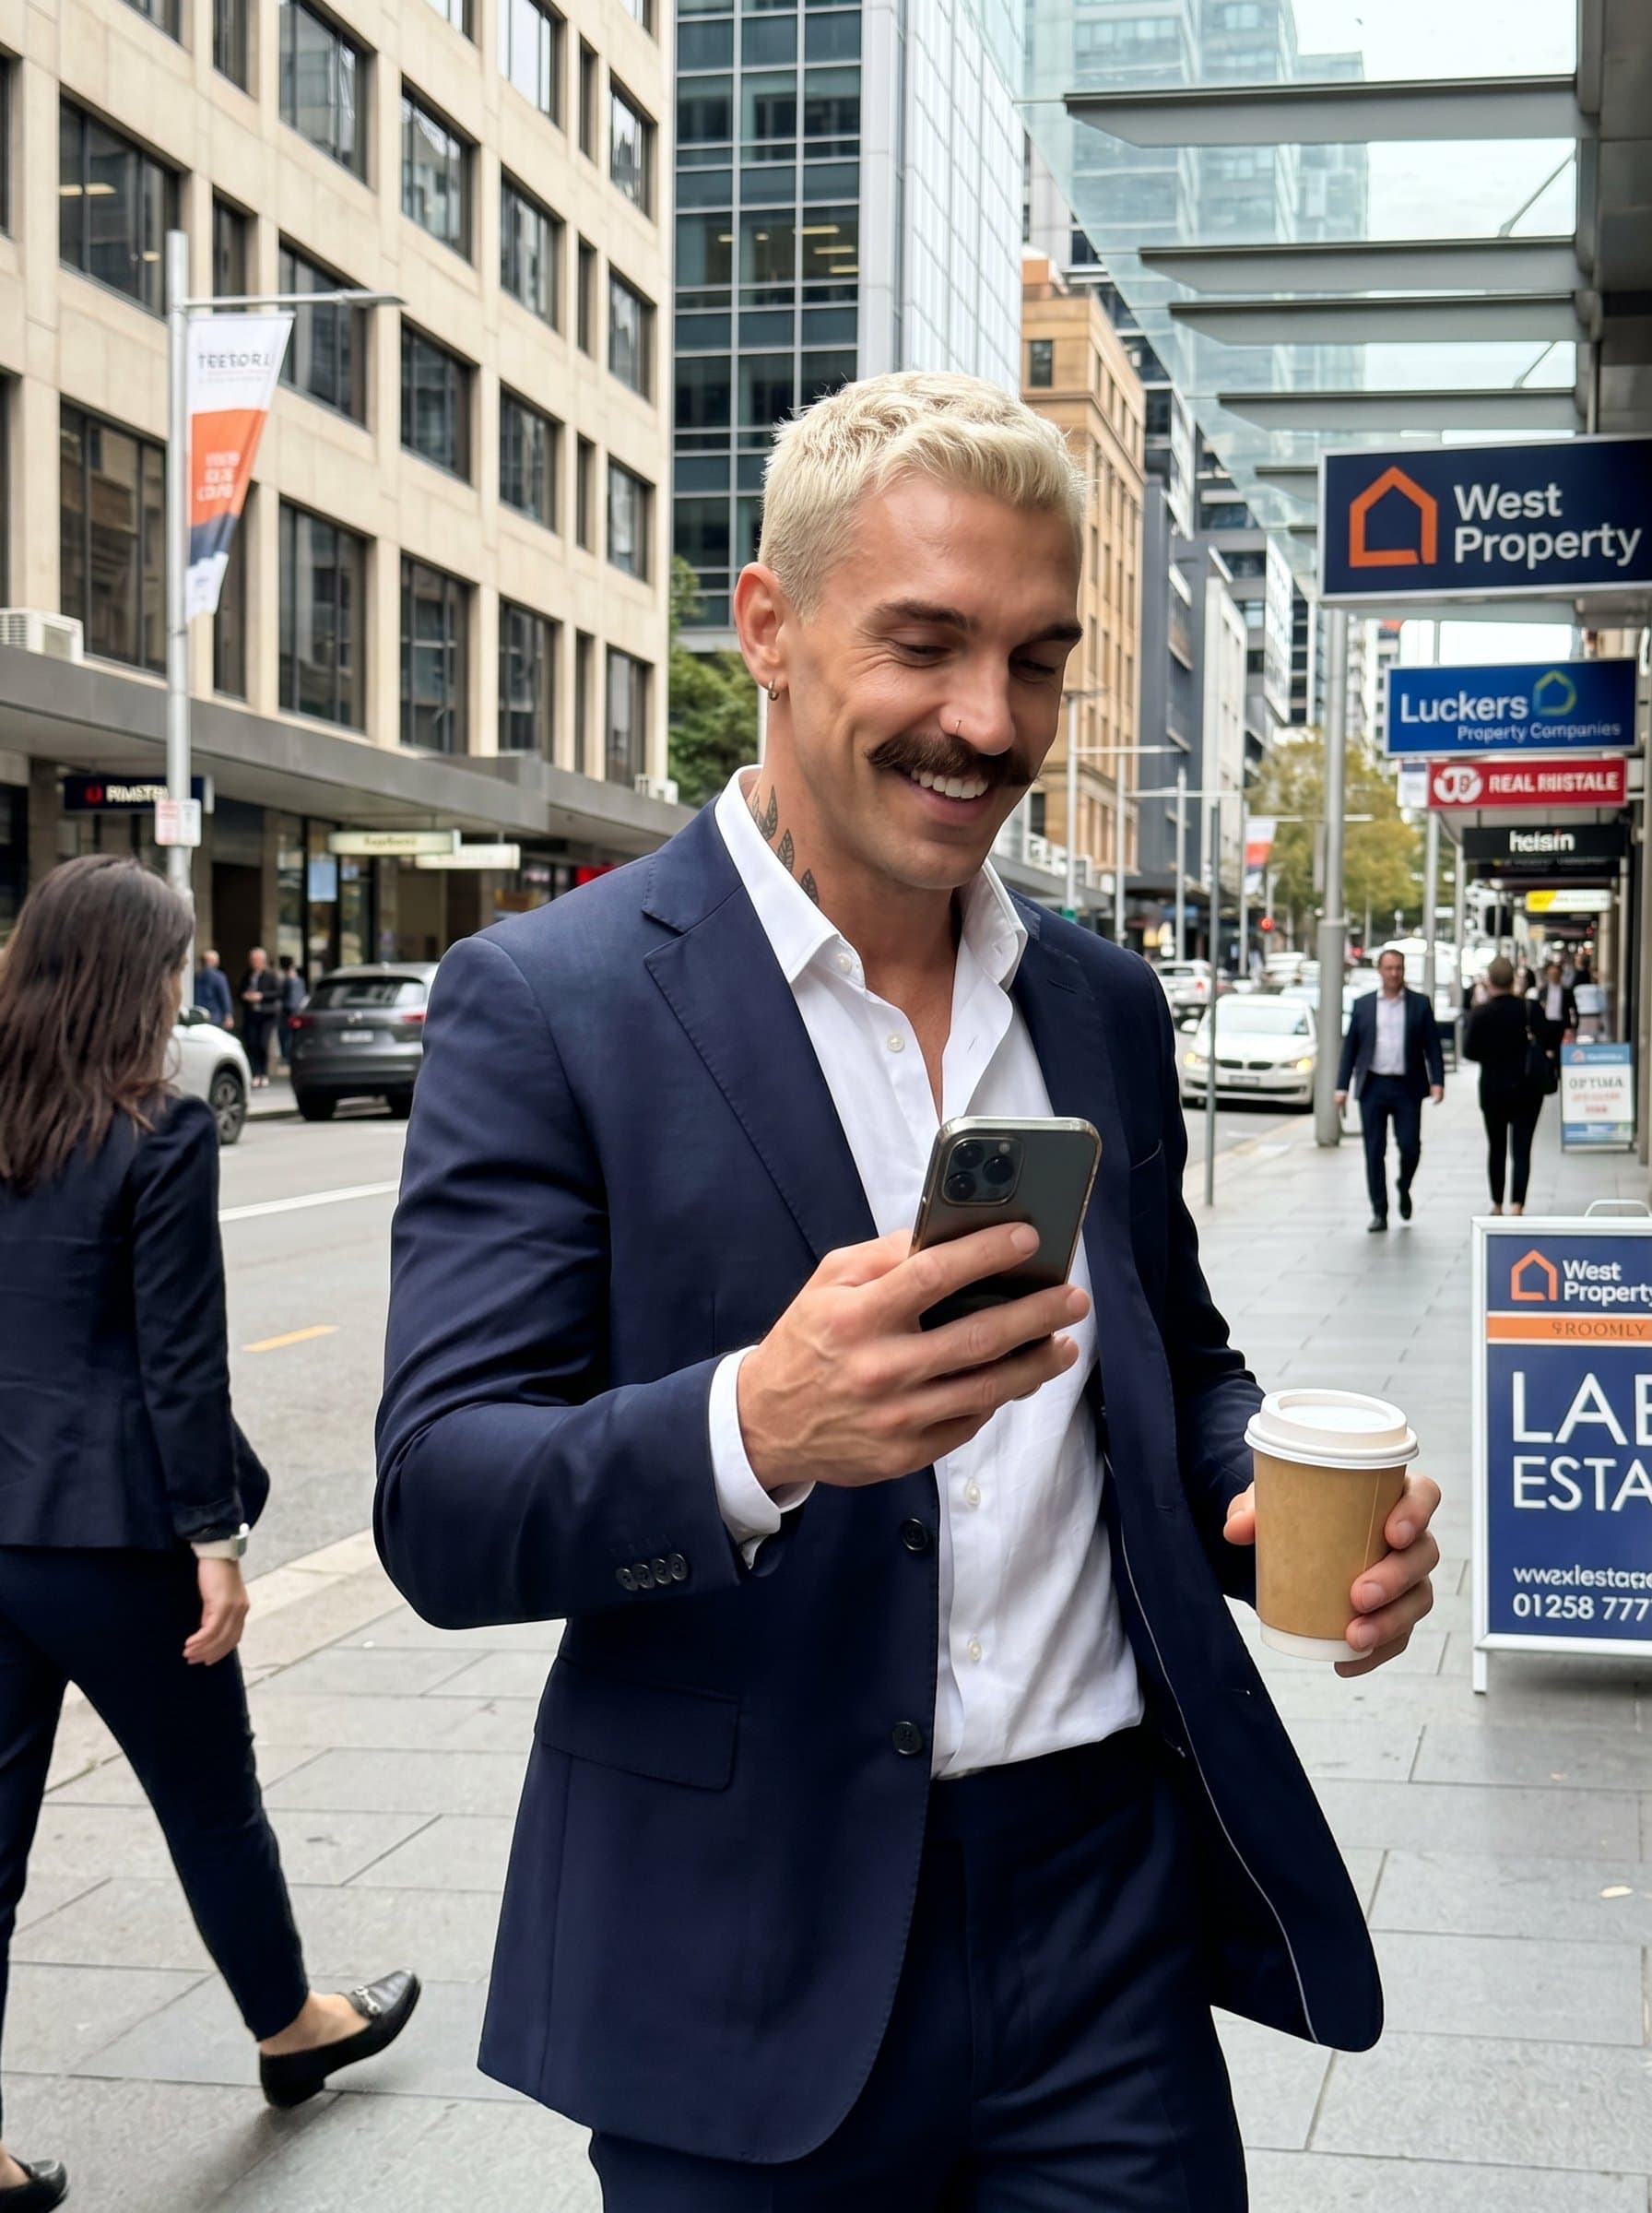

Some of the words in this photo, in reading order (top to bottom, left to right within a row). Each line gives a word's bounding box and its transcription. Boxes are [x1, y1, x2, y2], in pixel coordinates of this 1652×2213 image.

[1454, 483, 1563, 521] West
[1455, 523, 1642, 570] Property
[1400, 691, 1528, 723] Luckers
[1457, 725, 1528, 743] Property
[1530, 722, 1621, 740] Companies
[1489, 774, 1535, 794] REAL
[1563, 1260, 1622, 1281] West
[1514, 1456, 1652, 1511] ESTA
[1513, 1593, 1594, 1619] 01258
[1602, 1596, 1652, 1621] 777
